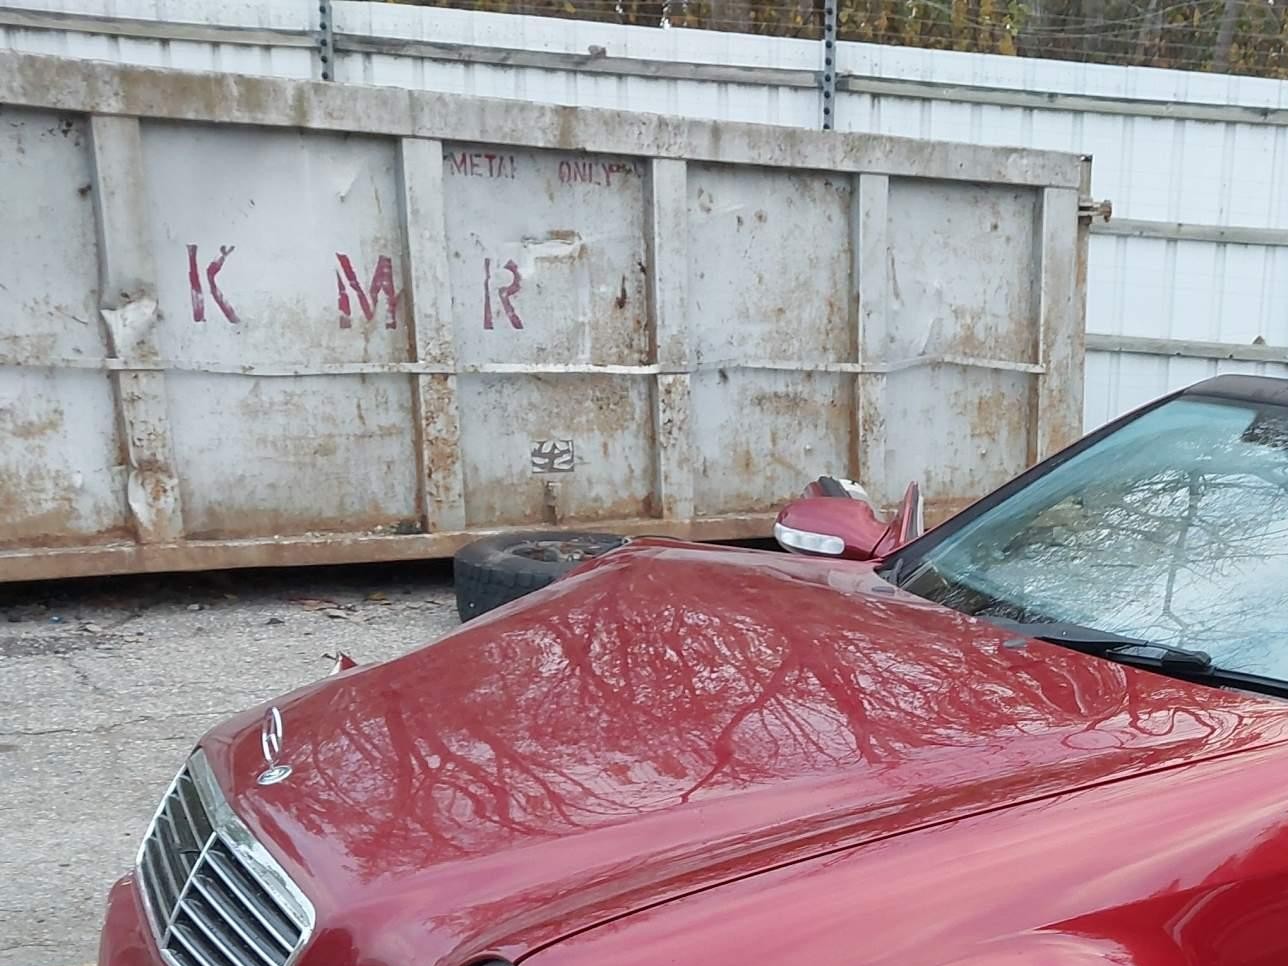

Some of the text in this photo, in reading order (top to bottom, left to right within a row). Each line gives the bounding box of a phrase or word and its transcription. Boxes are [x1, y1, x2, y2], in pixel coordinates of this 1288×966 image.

[186, 243, 524, 330] K M R
